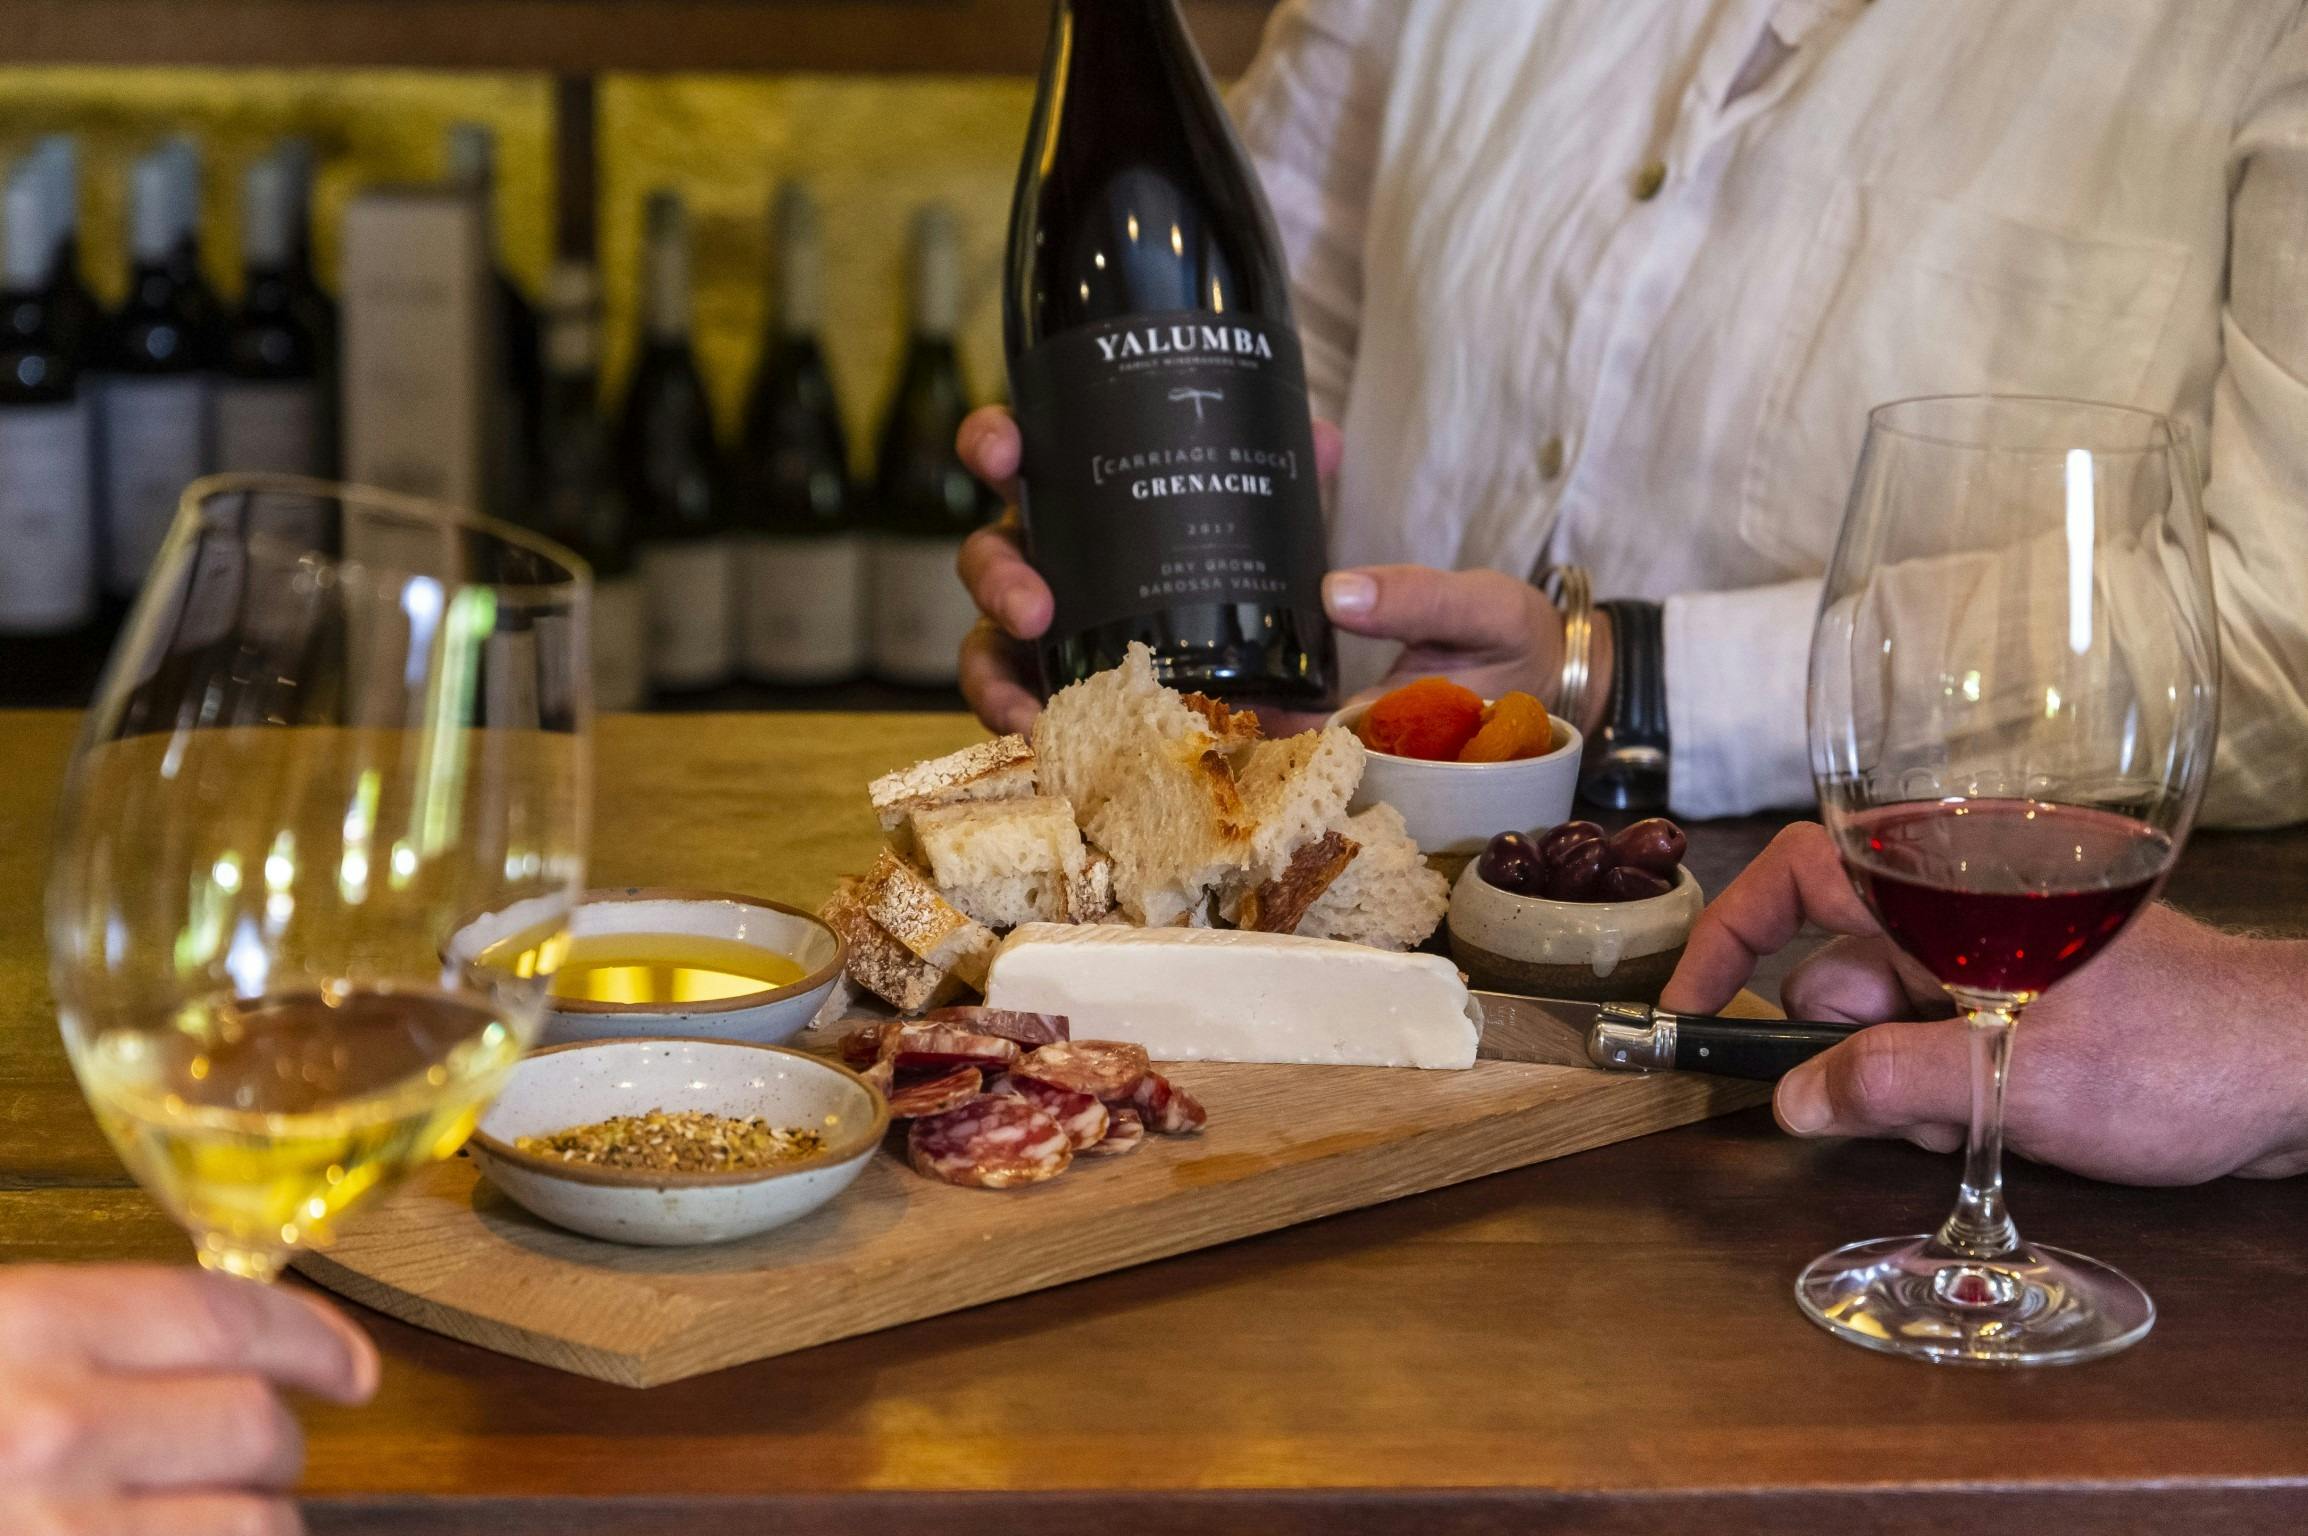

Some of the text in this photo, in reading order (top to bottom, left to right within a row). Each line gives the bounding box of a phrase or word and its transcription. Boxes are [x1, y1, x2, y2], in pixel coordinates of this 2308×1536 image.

[1096, 325, 1273, 361] YALUMBA
[1131, 472, 1273, 500] GRENACHE
[1161, 558, 1267, 576] DRY GROWN
[1139, 576, 1288, 598] BAROSSA VALLEY
